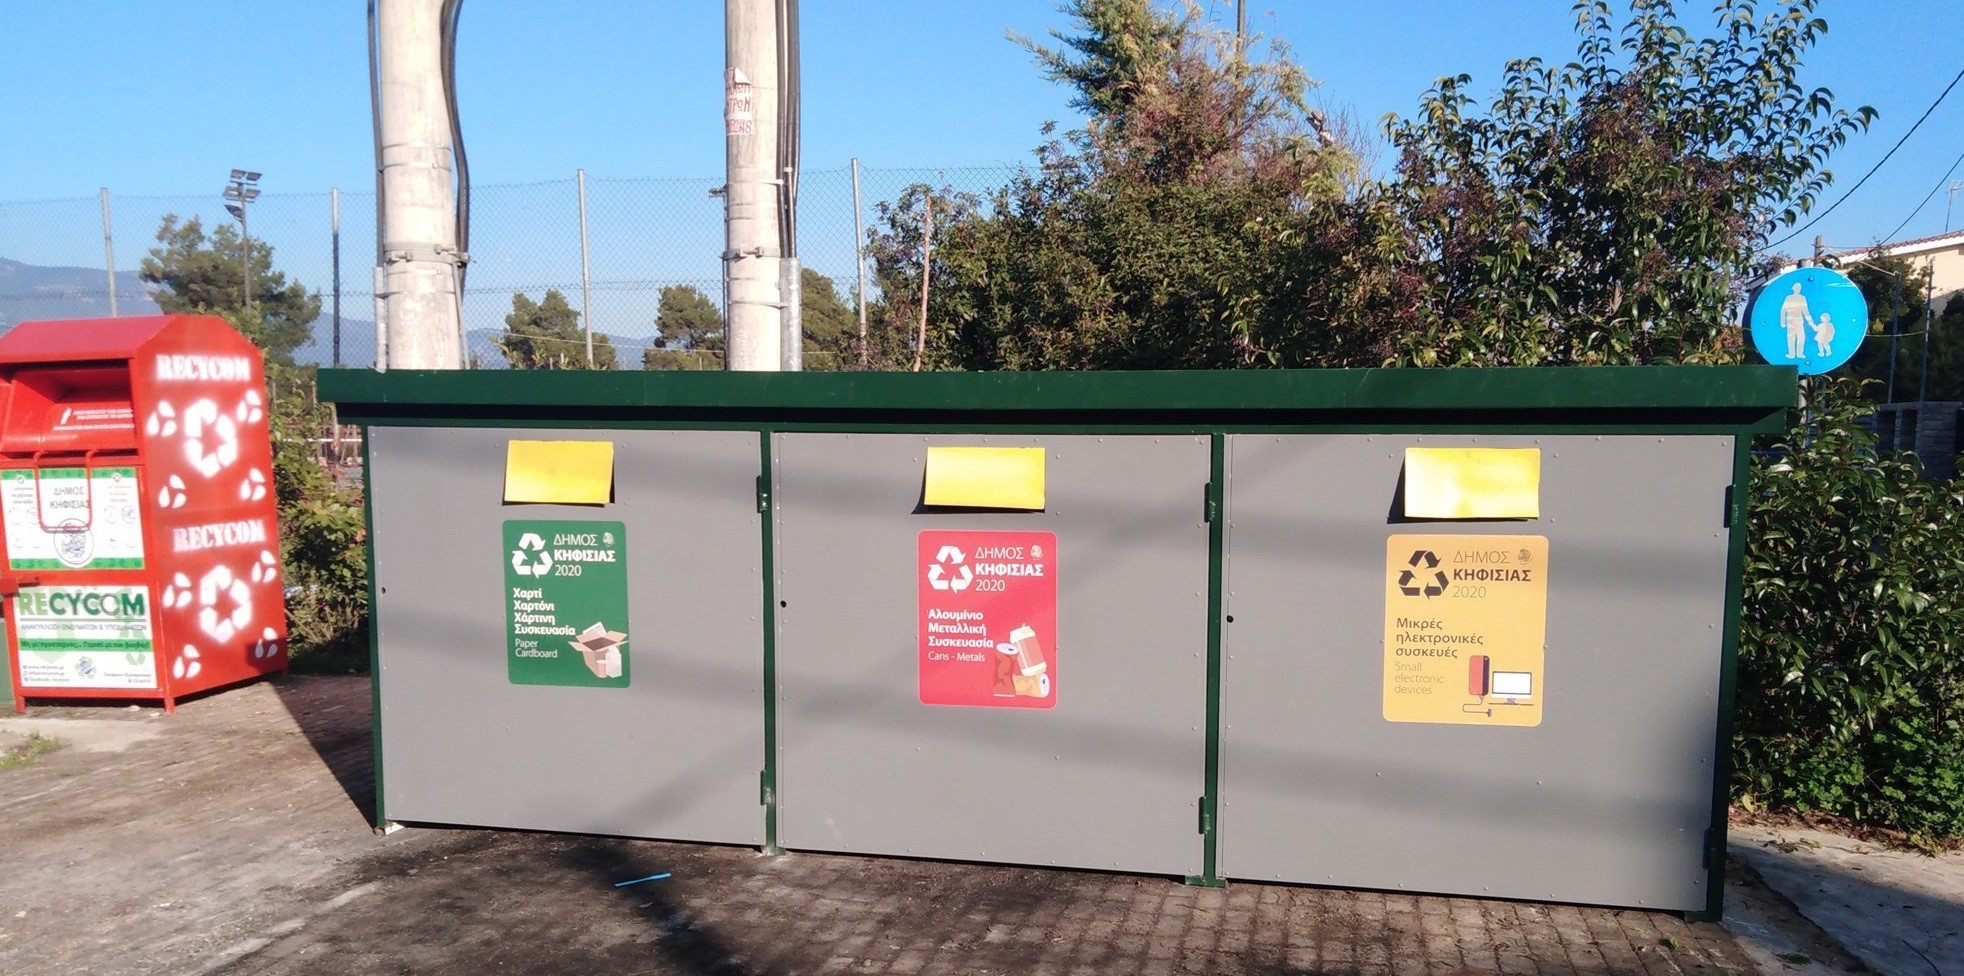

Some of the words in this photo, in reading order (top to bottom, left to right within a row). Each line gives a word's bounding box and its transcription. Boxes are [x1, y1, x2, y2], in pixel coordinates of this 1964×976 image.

[156, 354, 251, 381] RECYCOM
[54, 486, 85, 495] ΔΗΜΟΣ
[50, 500, 91, 509] ΚΗΦΙΣΙΑΣ
[172, 519, 266, 552] RECYCOM
[553, 534, 598, 546] ΔΗΜΟΣ
[554, 550, 616, 562] ΚΗΦΙΣΙΑΣ
[975, 547, 1024, 559] ΔΗΜΟΣ
[1453, 551, 1510, 564] ΔΗΜΟΣ
[554, 565, 582, 577] 2020
[975, 563, 1044, 577] ΚΗΦΙΣΙΑΣ
[1453, 569, 1532, 582] ΚΗΦΙΣΙΑΣ
[975, 579, 1006, 592] 2020
[513, 588, 542, 600] Χαρτί
[1452, 586, 1487, 598] 2020
[19, 592, 145, 616] RECYCOM
[513, 600, 555, 613] Χαρτόνι
[514, 612, 555, 625] Χάρτινη
[928, 609, 984, 621] Αλουμίνιο
[514, 624, 576, 636] Συσκευασία
[928, 622, 986, 636] Μεταλλική
[1396, 618, 1443, 631] Μικρές
[515, 639, 538, 649] Paper
[928, 636, 994, 648] Συσκευασία
[1396, 631, 1484, 646] ηλεκτρονικές
[515, 648, 558, 659] Cardboard
[928, 651, 950, 661] Cans
[957, 651, 986, 662] Metals
[1395, 646, 1458, 659] συσκευές
[1394, 661, 1422, 672] Small
[1394, 673, 1445, 684] electronic
[1393, 685, 1432, 695] devices
